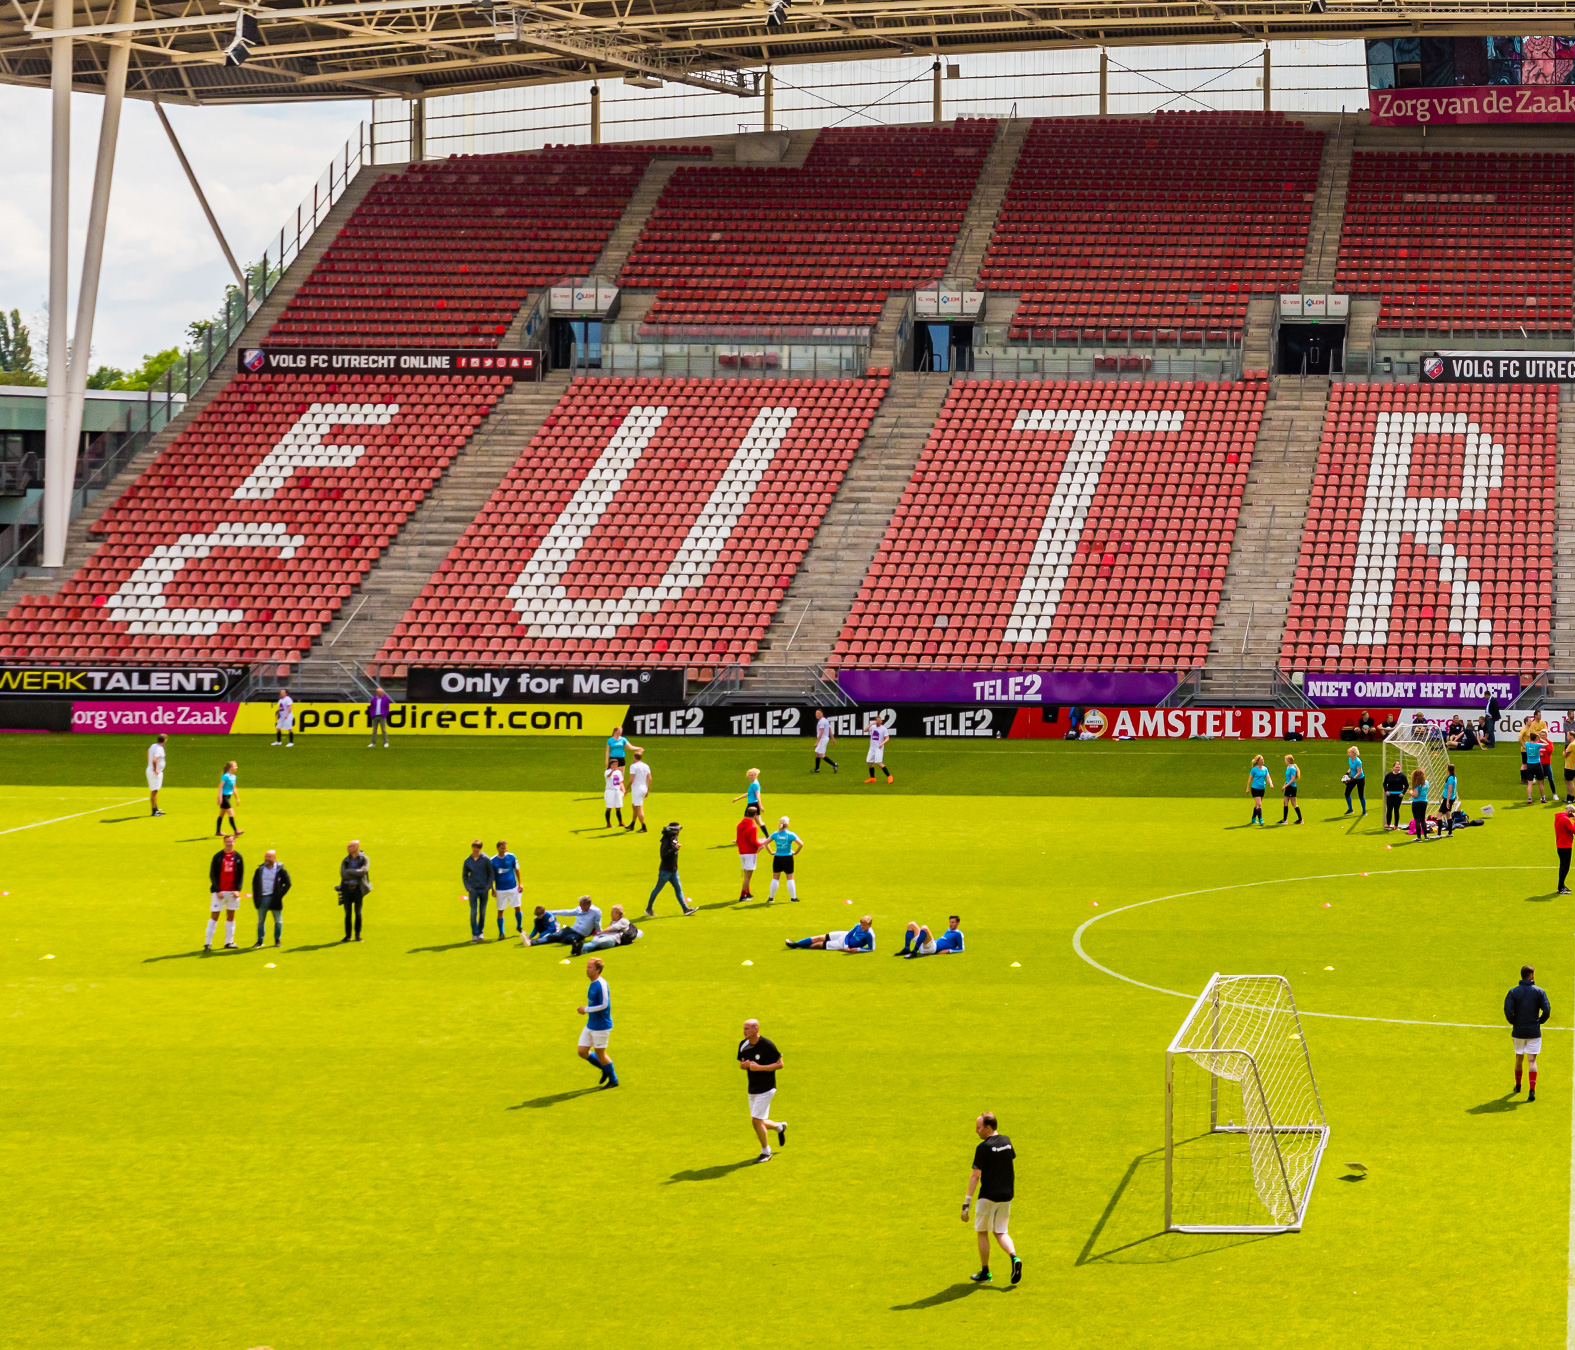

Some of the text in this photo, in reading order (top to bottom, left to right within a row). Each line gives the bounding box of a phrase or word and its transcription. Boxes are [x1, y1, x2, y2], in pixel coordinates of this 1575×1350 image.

[1379, 94, 1430, 121] Zorg
[1433, 98, 1480, 115] van
[1483, 90, 1512, 113] de
[269, 354, 306, 368] VOLG
[310, 355, 328, 368] FC
[332, 355, 397, 368] UTRECHT
[400, 355, 450, 368] ONLINE
[1452, 359, 1494, 378] VOLG
[1499, 360, 1519, 378] FC
[441, 672, 638, 697] Only for Men
[973, 674, 1042, 701] TELE2
[1308, 681, 1512, 700] NIET OMDAT HET MOET,
[71, 706, 228, 729] org van de Zaak
[275, 704, 583, 732] portdirect.com
[633, 707, 704, 736] TELE2
[730, 707, 801, 736] TELE2
[827, 708, 897, 736] TELE2
[922, 708, 993, 736] TELE2
[1251, 710, 1329, 738] BIER
[1500, 715, 1522, 732] de
